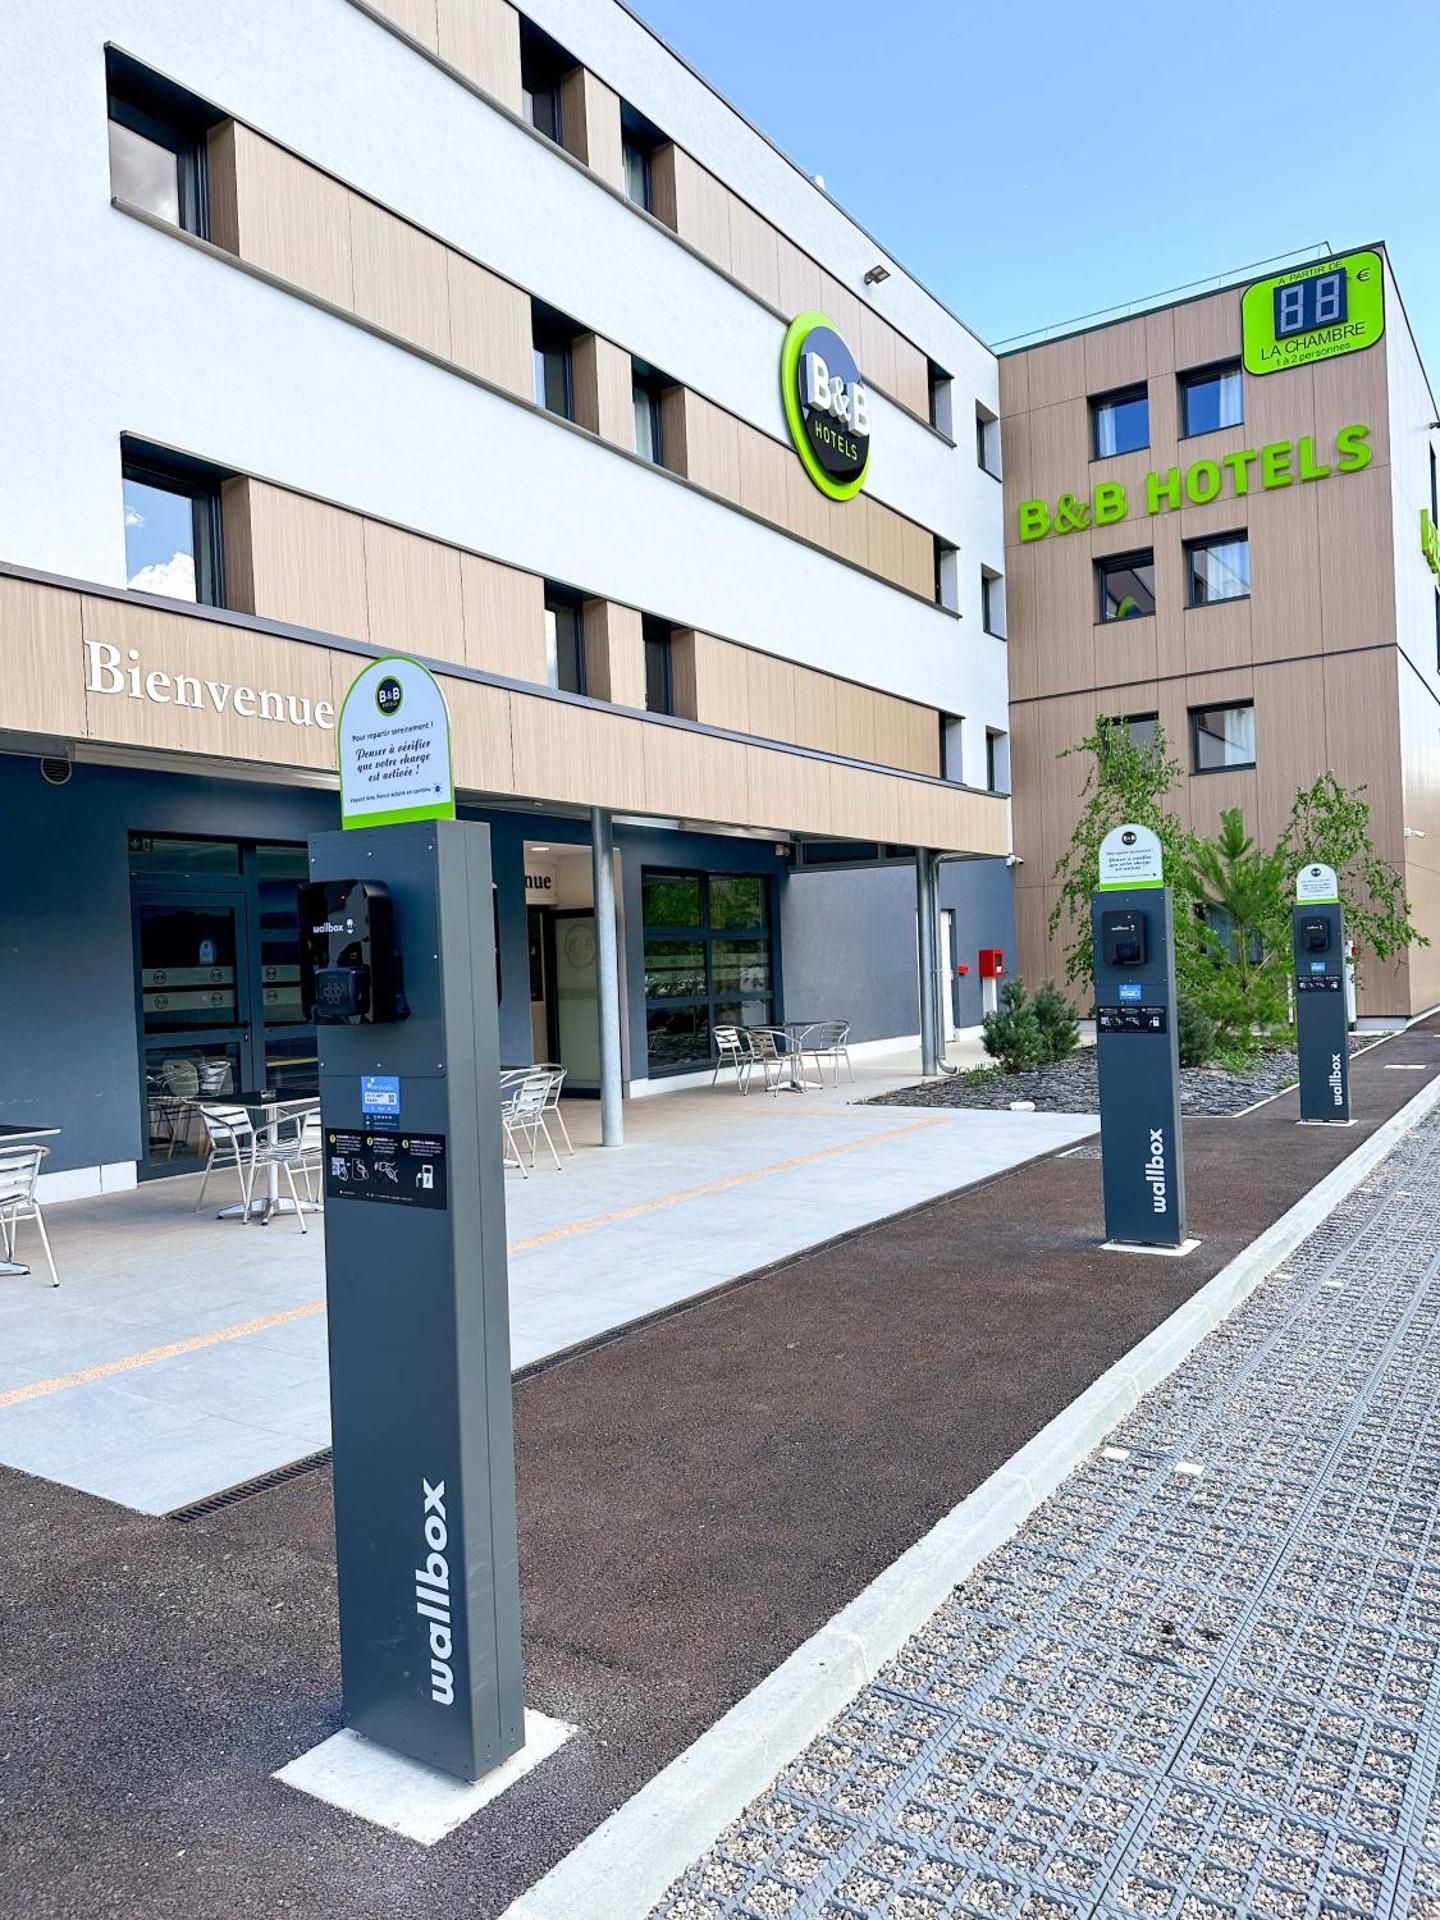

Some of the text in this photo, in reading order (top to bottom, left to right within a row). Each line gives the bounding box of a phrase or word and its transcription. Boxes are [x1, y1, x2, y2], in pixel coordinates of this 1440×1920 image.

[1289, 264, 1325, 282] PARTIR
[1328, 260, 1342, 271] DE
[1356, 267, 1370, 282] €
[1260, 320, 1366, 361] LA CHAMBRE
[1283, 355, 1290, 366] à
[1291, 353, 1298, 363] 2
[1299, 341, 1351, 362] personnes
[802, 351, 870, 438] B&B
[815, 420, 858, 461] HOTELS
[1018, 424, 1373, 543] B&B HOTELS
[84, 639, 335, 730] Bienvenue
[378, 687, 401, 704] B&B
[351, 734, 366, 743] Pour
[366, 729, 390, 742] repartir
[355, 739, 431, 762] Penser à vérifier
[357, 751, 431, 773] que votre charge
[368, 771, 380, 783] est
[382, 767, 413, 781] activée
[312, 922, 344, 934] wallbox
[1328, 1052, 1343, 1106] wallbox
[1145, 1128, 1167, 1213] wallbox
[415, 1477, 454, 1706] wallbox
